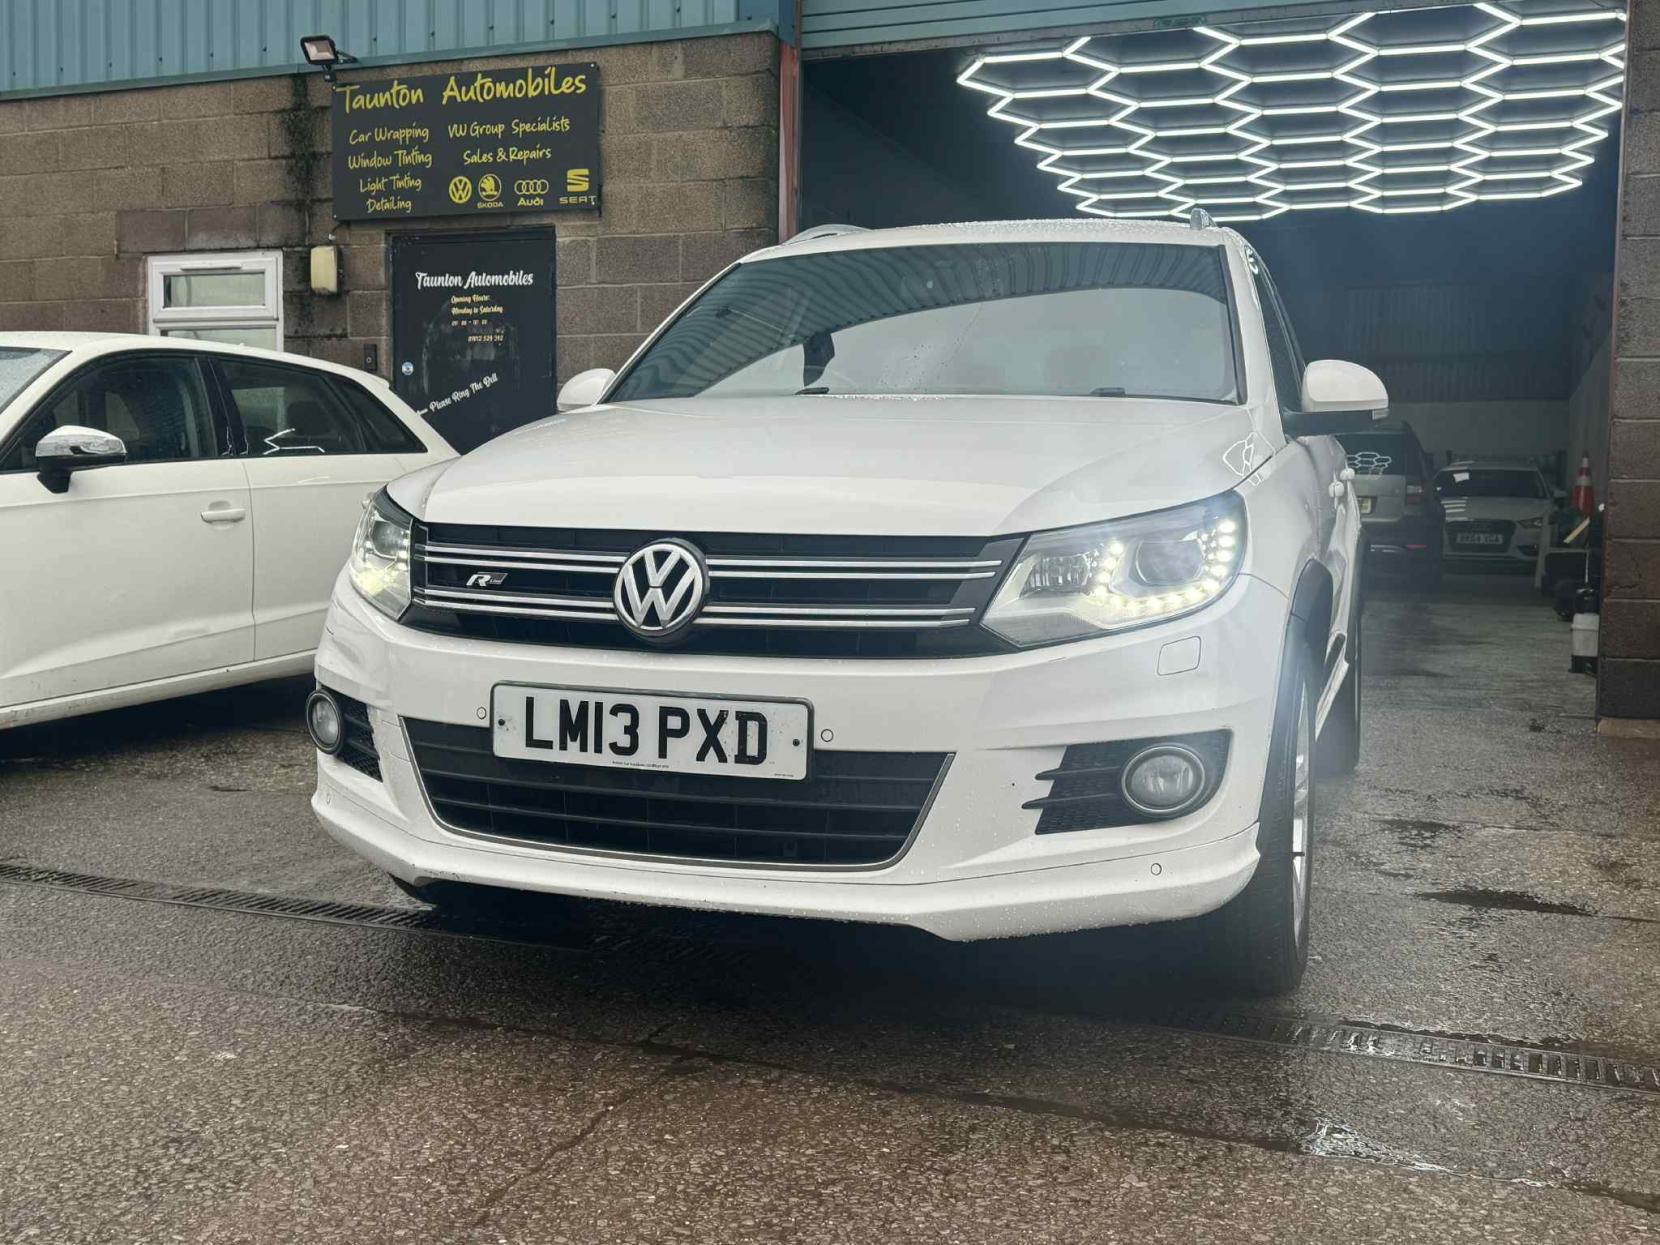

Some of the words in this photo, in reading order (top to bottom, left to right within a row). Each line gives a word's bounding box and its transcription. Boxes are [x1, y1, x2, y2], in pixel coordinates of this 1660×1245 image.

[335, 80, 424, 114] Taunton
[442, 66, 587, 105] Automobiles
[349, 129, 372, 145] Car
[374, 121, 429, 145] Wrapping
[448, 123, 468, 139] VW
[470, 121, 505, 139] Group
[511, 115, 570, 138] Specialists
[348, 150, 392, 170] Window
[394, 145, 433, 168] Tinting
[463, 148, 494, 165] Sales
[496, 147, 508, 162] &
[509, 143, 552, 166] Repairs
[360, 176, 389, 195] Light
[389, 172, 422, 192] Tinting
[366, 196, 412, 213] Detailing
[517, 197, 544, 206] Audi
[559, 195, 597, 205] SEAT
[415, 271, 463, 290] Taunton
[463, 270, 534, 290] Automobiles
[429, 397, 452, 413] Please
[451, 388, 470, 403] Ring
[469, 381, 483, 394] The
[482, 372, 498, 388] Bell
[525, 696, 640, 756] LM13
[658, 705, 768, 766] PXD
